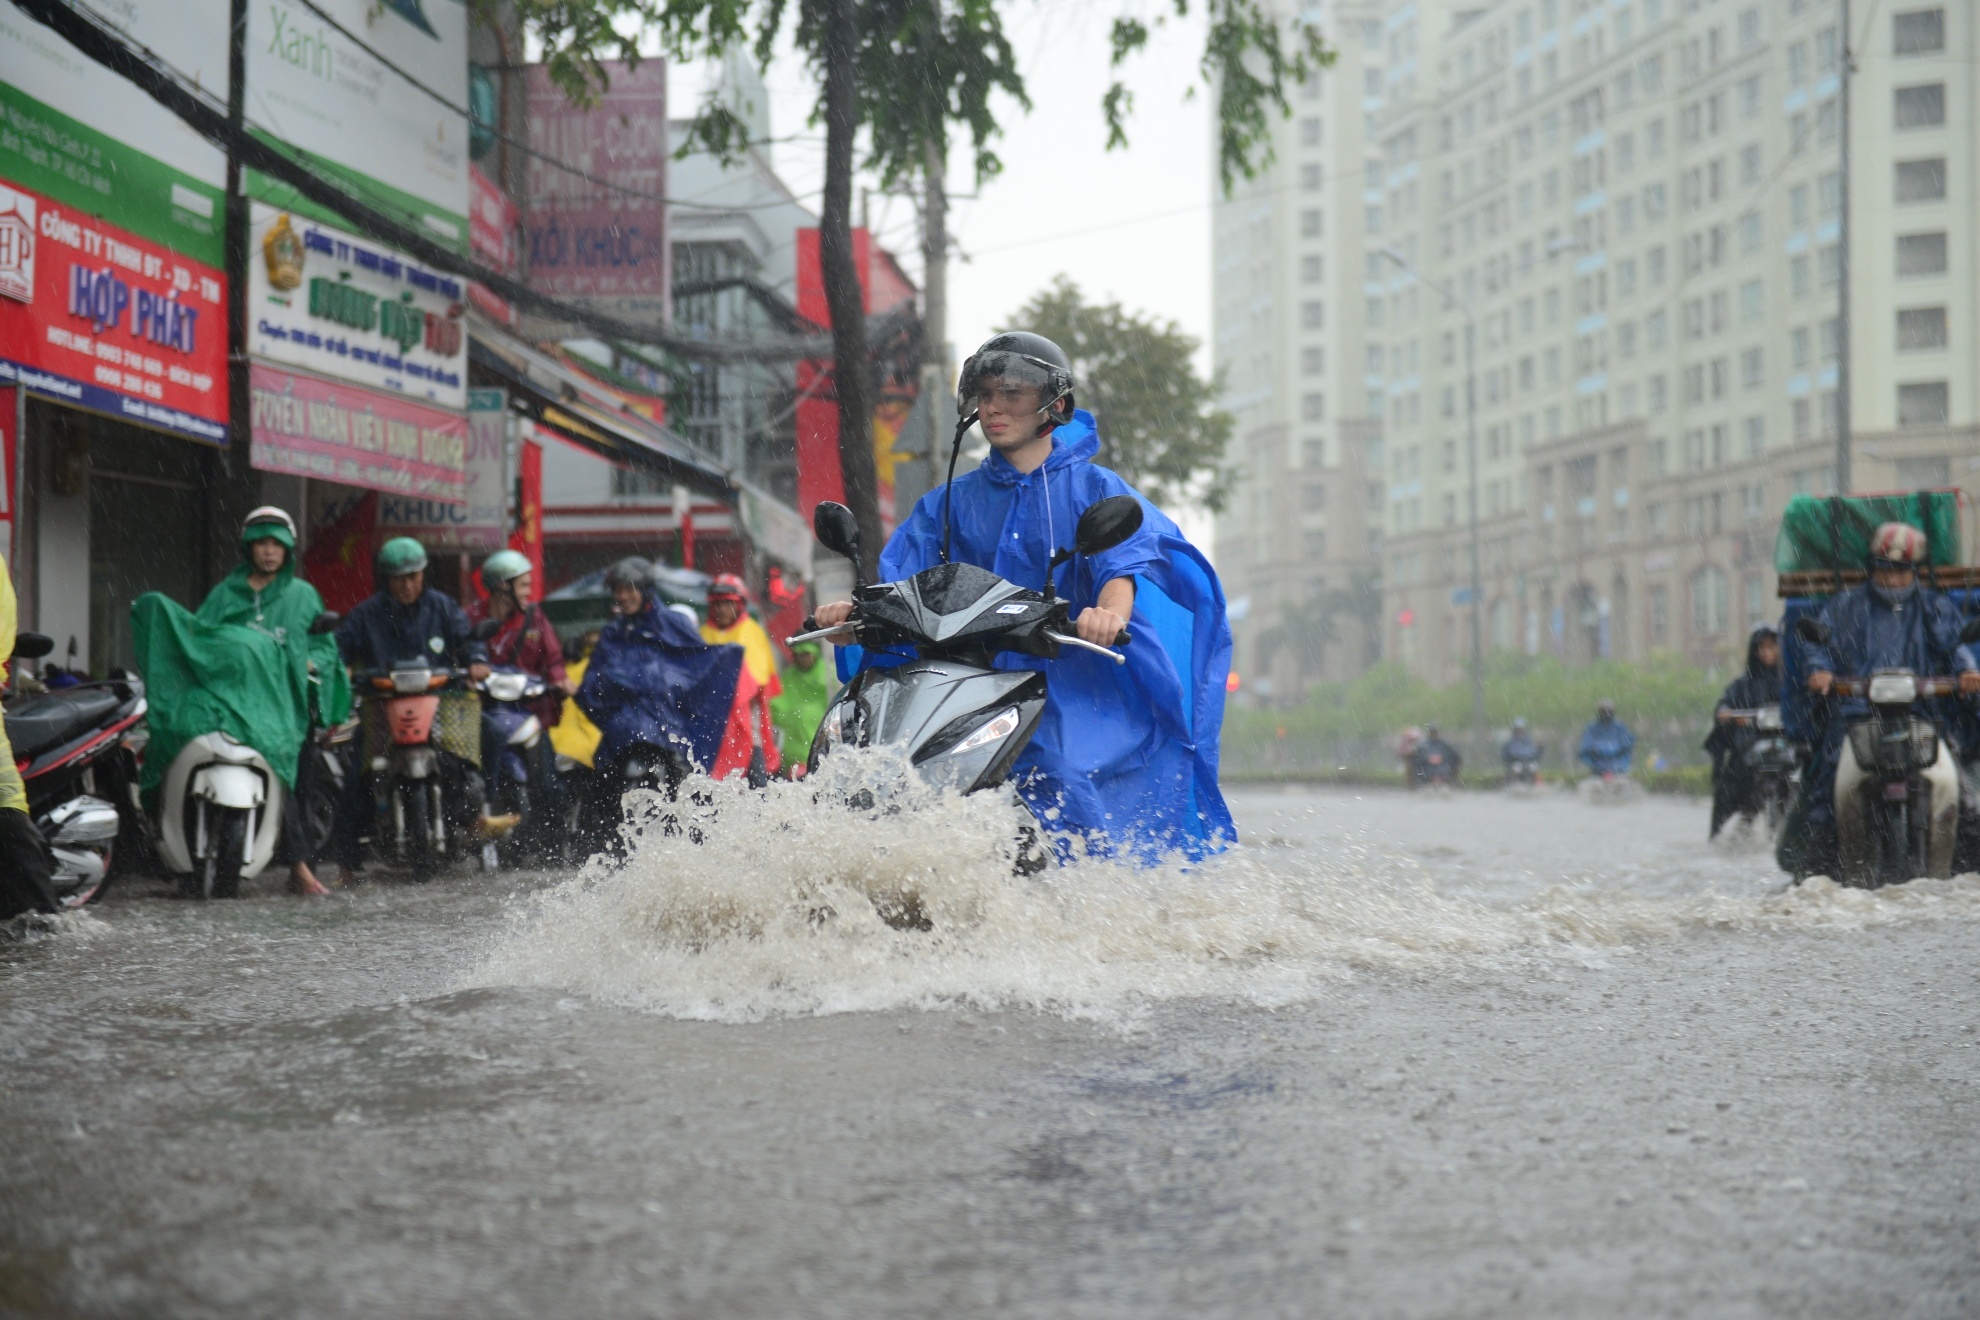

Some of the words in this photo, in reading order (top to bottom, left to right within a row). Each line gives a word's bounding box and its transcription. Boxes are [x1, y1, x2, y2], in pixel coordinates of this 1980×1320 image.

[267, 2, 334, 83] Xanh
[40, 209, 80, 249] CÔNG
[83, 228, 101, 256] TY
[104, 237, 141, 274] TNHH
[172, 263, 191, 293] XD
[200, 274, 220, 305] TM
[47, 324, 95, 357] HOTLINE:
[68, 264, 130, 335] HỢP
[130, 286, 198, 354] PHÁT
